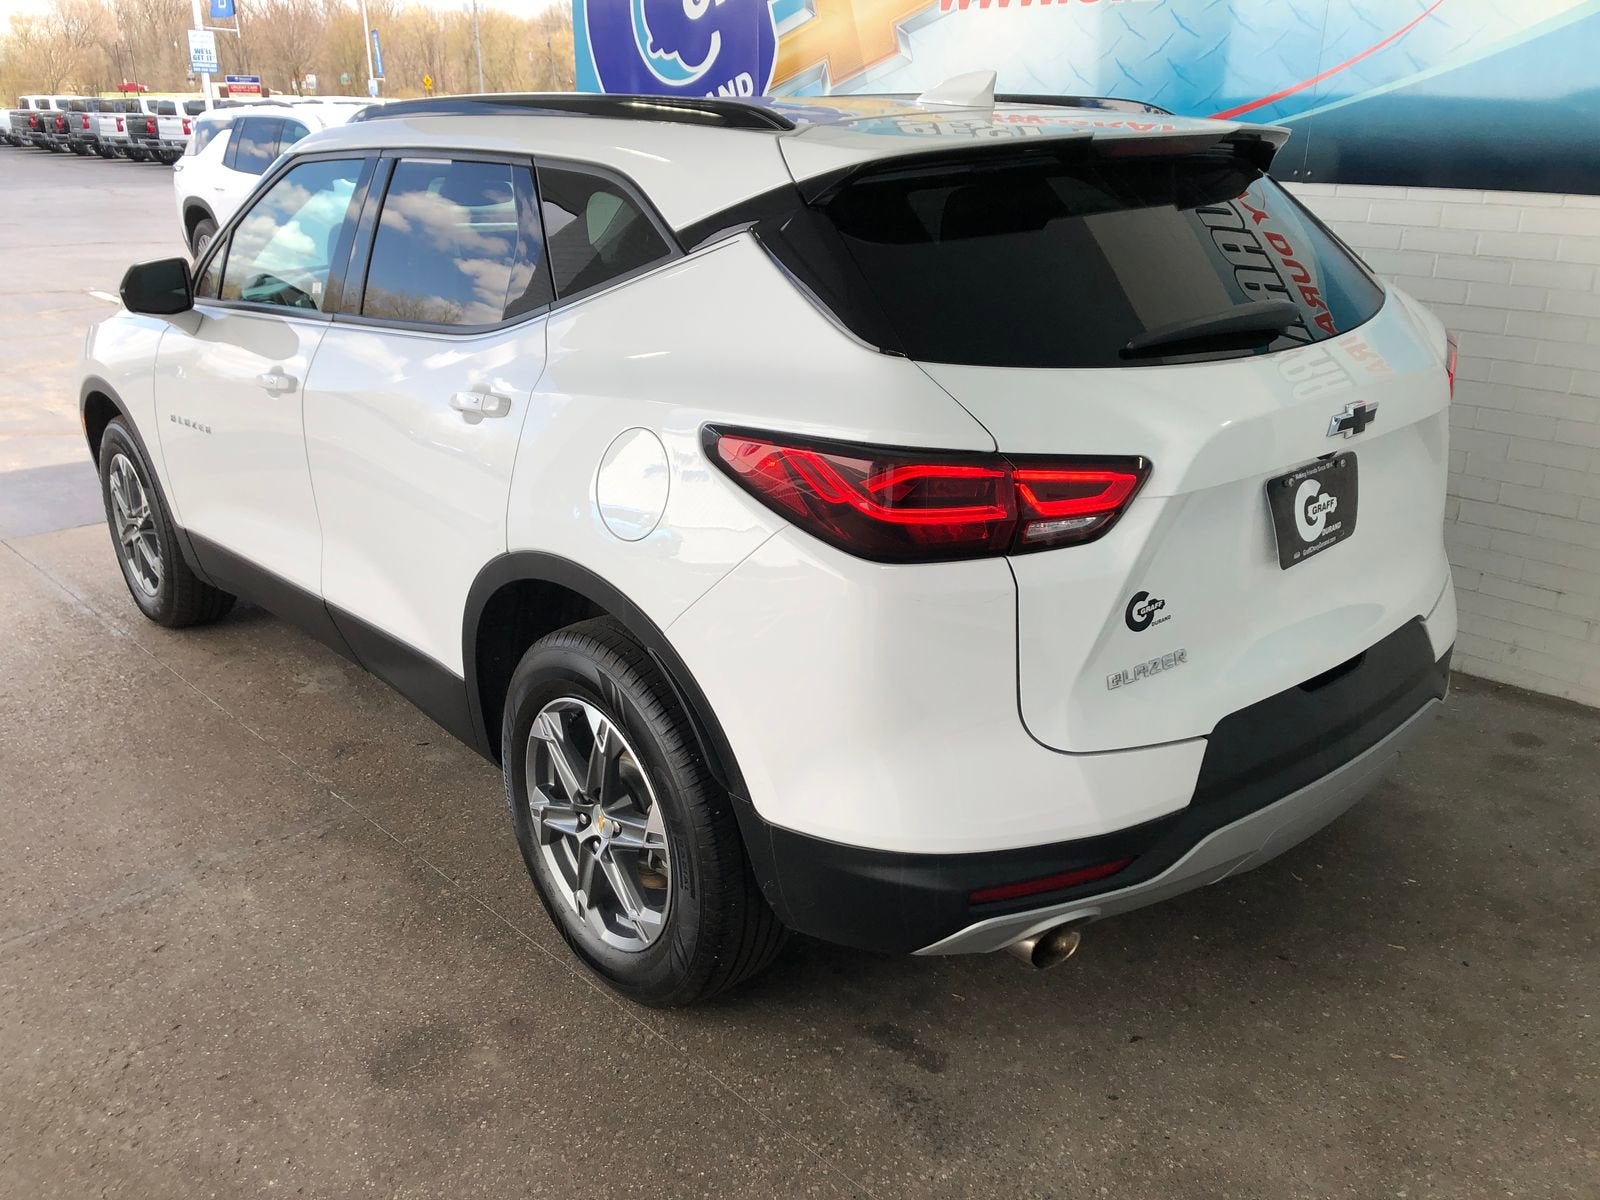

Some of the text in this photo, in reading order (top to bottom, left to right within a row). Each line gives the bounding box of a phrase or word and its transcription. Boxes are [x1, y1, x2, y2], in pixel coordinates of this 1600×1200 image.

[1312, 499, 1335, 515] GRAFF
[1322, 521, 1342, 537] DURAND
[1140, 600, 1164, 614] GRAFF
[1152, 615, 1171, 627] DURAND
[1106, 648, 1187, 691] BLAZER
